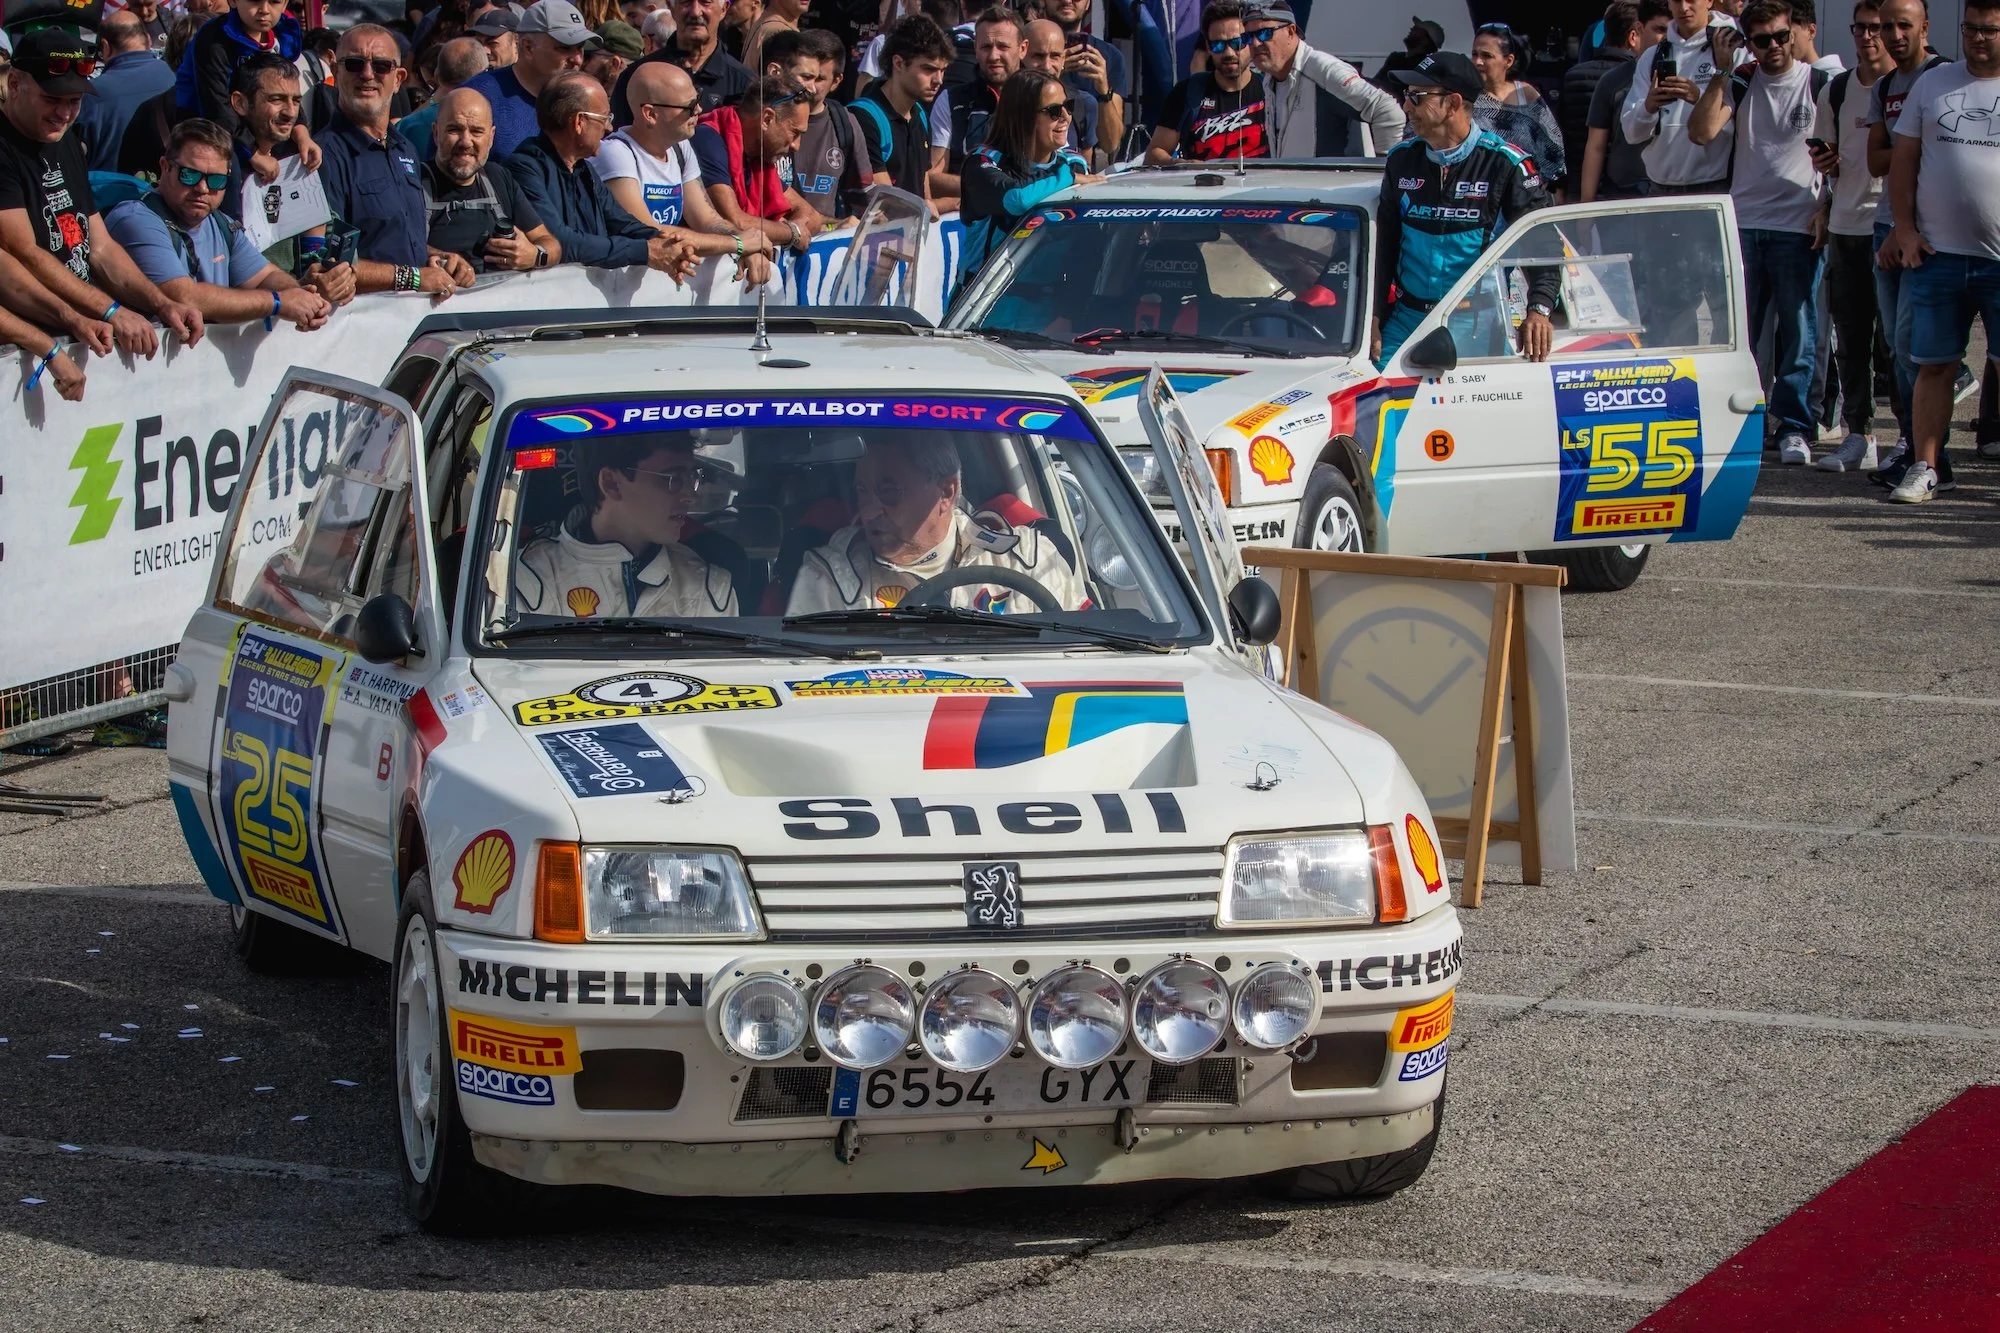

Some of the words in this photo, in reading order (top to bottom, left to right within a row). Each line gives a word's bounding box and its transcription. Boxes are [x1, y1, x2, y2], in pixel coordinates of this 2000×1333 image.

[1937, 136, 1965, 144] UNDER
[1966, 139, 2000, 148] ARMOU
[647, 187, 674, 195] PEUGEOT
[1456, 181, 1489, 192] G&G
[1084, 209, 1157, 218] PEUGEOT
[1158, 208, 1222, 218] TALBOT
[1222, 209, 1282, 219] SPORT
[1408, 206, 1480, 219] AIRTECO
[1447, 376, 1458, 384] B.
[1461, 375, 1487, 384] SABY
[1559, 381, 1600, 390] LEGEND
[1451, 395, 1468, 404] J.F.
[1472, 392, 1524, 402] FAUCHILLE
[1583, 387, 1667, 412] sparco
[622, 403, 763, 423] PEUGEOT
[771, 403, 885, 416] TALBOT
[892, 403, 987, 421] SPORT
[1235, 405, 1282, 430] PIRELLI
[1279, 414, 1326, 432] AIRTECO
[1432, 435, 1450, 457] B
[1562, 428, 1592, 450] LS
[1586, 420, 1699, 492] 55
[1583, 501, 1675, 528] PIRELLI
[238, 658, 267, 674] LEGEND
[267, 668, 290, 682] STARS
[619, 682, 659, 698] 4
[791, 678, 1008, 690] RALLYLEGEND
[795, 688, 945, 697] COMPETITOR
[248, 678, 303, 718] sparco
[529, 706, 627, 724] OKO
[641, 698, 767, 714] BANK
[376, 742, 393, 782] B
[562, 730, 635, 777] EBERHARD
[234, 733, 313, 863] 25
[777, 791, 1188, 840] Shell
[247, 855, 317, 910] PIRELLI
[458, 958, 703, 1007] MICHELIN
[458, 1019, 566, 1067] PIRELLI
[1405, 1035, 1449, 1078] sparco
[460, 1063, 550, 1097] sparco
[866, 1066, 996, 1109] 6554
[1040, 1059, 1136, 1104] GYX
[838, 1097, 850, 1109] E
